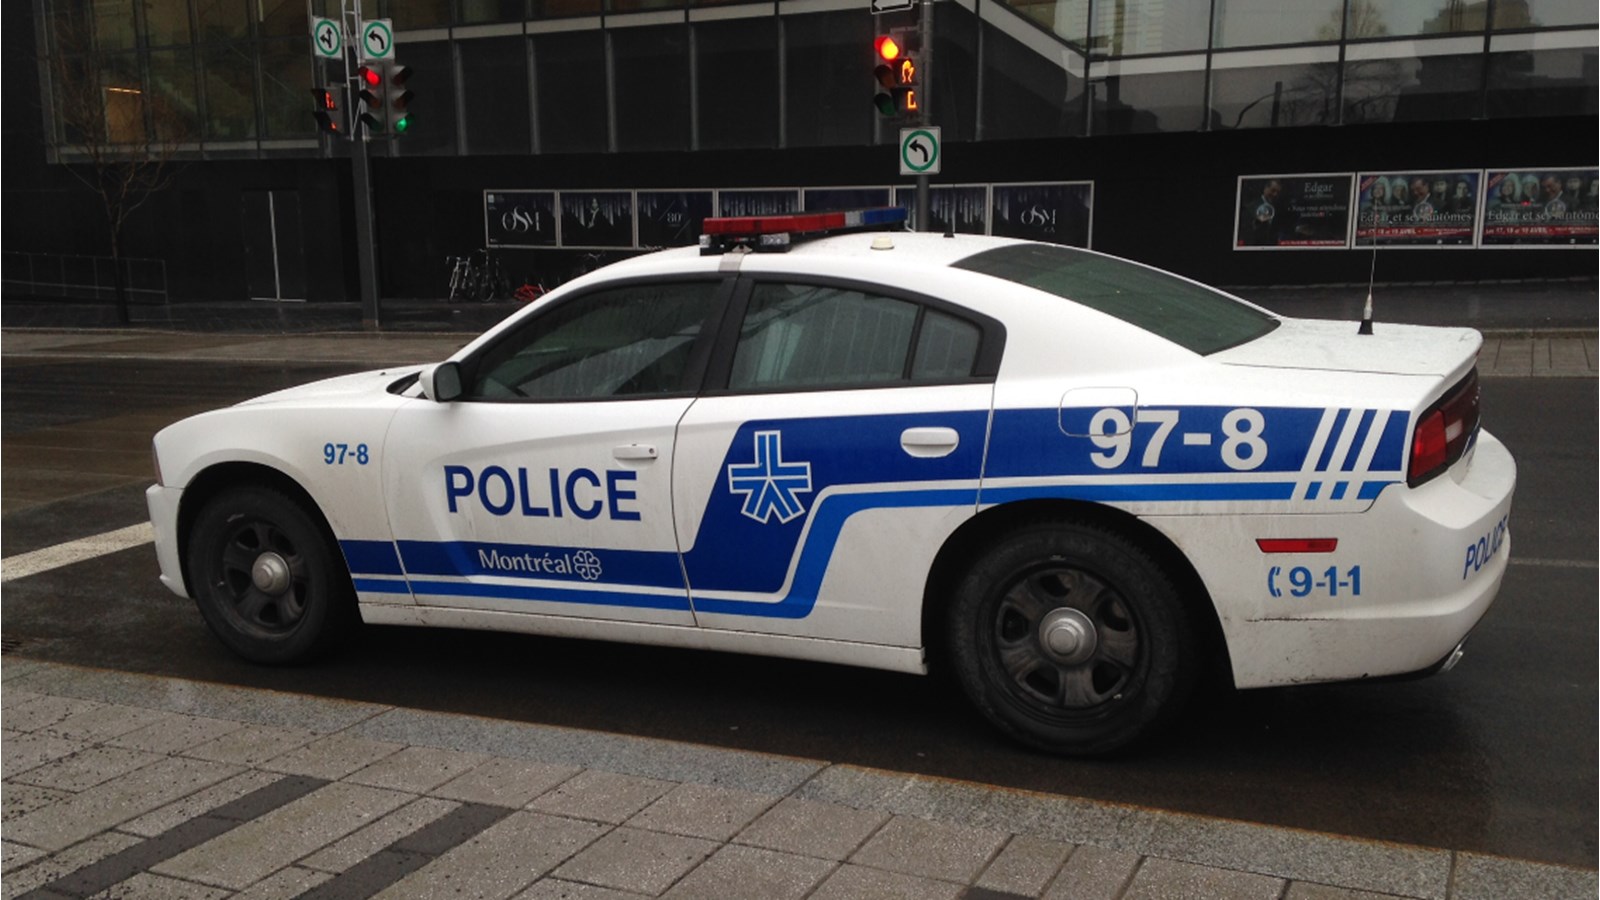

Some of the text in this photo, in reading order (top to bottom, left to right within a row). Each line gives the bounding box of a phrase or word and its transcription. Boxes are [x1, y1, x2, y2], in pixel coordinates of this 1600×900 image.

[1304, 182, 1334, 195] Edgar
[502, 206, 541, 232] OSM
[1021, 205, 1056, 225] OSM
[1488, 210, 1520, 223] Edgar
[1523, 211, 1533, 220] et
[1089, 408, 1268, 470] 97-8
[323, 442, 369, 465] 97-8
[444, 465, 641, 521] POLICE
[478, 549, 573, 575] Montréal
[1289, 565, 1361, 597] 9-1-1
